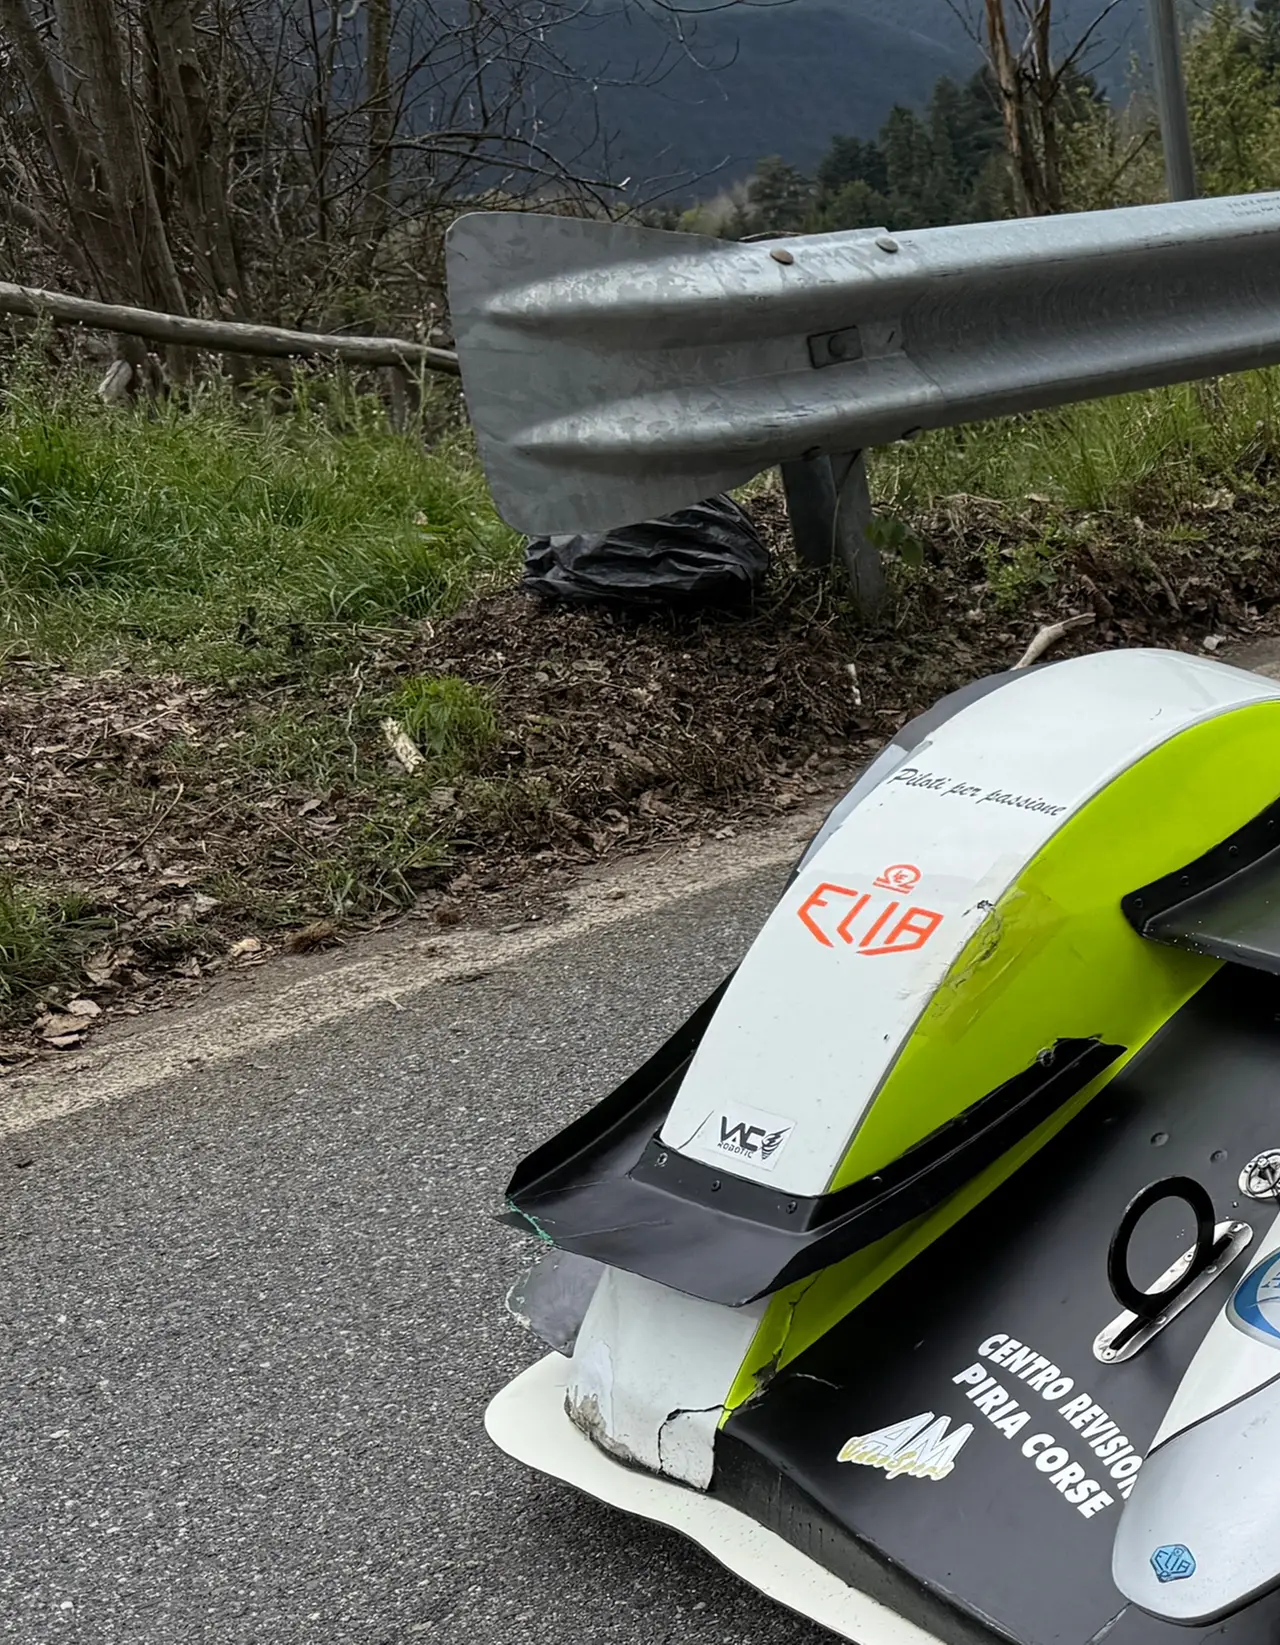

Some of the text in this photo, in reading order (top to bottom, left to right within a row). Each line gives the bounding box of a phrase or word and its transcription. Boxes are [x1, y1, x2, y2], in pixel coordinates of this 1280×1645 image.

[892, 767, 1068, 817] Piloti per passione
[717, 1142, 754, 1159] ROBOTIC
[977, 1333, 1074, 1401] CENTRO
[952, 1362, 1115, 1519] PIRIA CORSE
